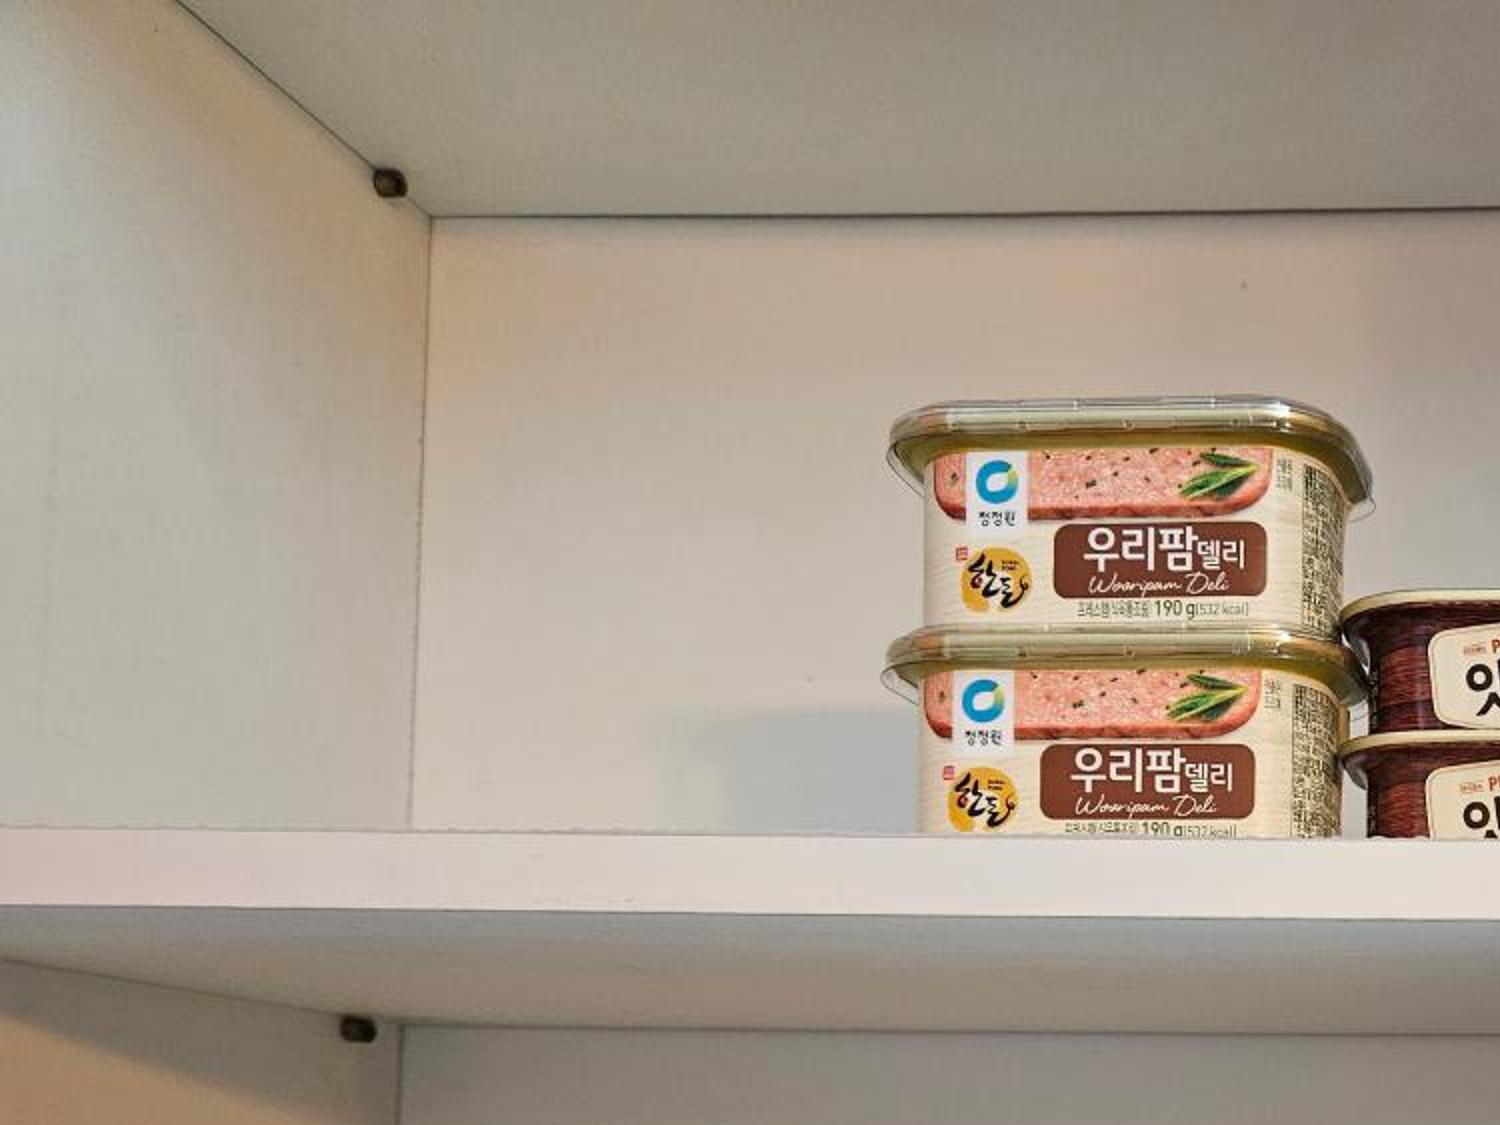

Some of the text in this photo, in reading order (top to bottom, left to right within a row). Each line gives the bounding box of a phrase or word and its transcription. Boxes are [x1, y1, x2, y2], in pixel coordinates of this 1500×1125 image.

[979, 511, 1015, 527] 청정원
[1186, 571, 1231, 594] Deli
[1155, 600, 1181, 616] 190
[964, 730, 1003, 746] 청정원
[1172, 793, 1217, 817] Deli
